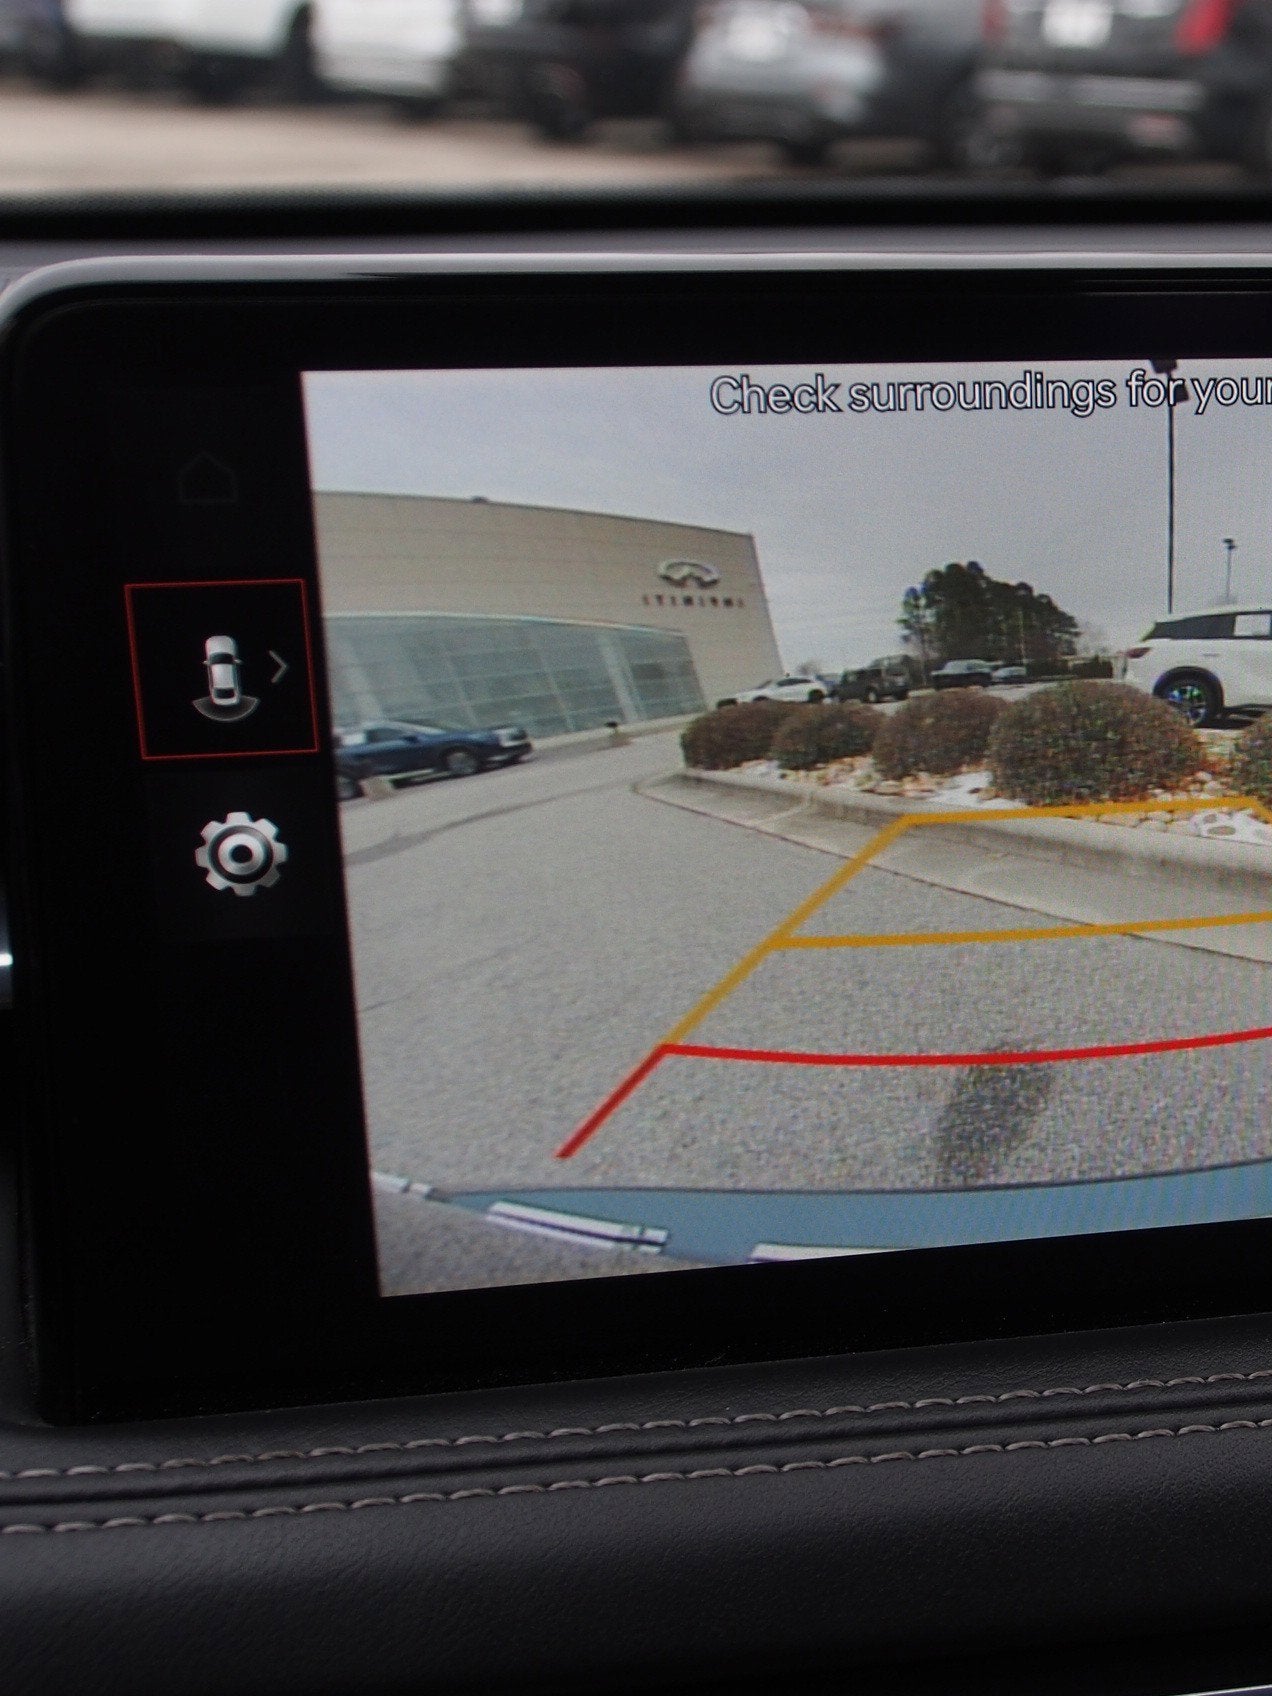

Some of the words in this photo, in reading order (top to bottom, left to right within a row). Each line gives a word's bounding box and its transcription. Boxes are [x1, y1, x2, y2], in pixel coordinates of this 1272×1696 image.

[710, 373, 842, 414] Check
[848, 370, 1116, 418] surroundings
[1126, 368, 1185, 407] for
